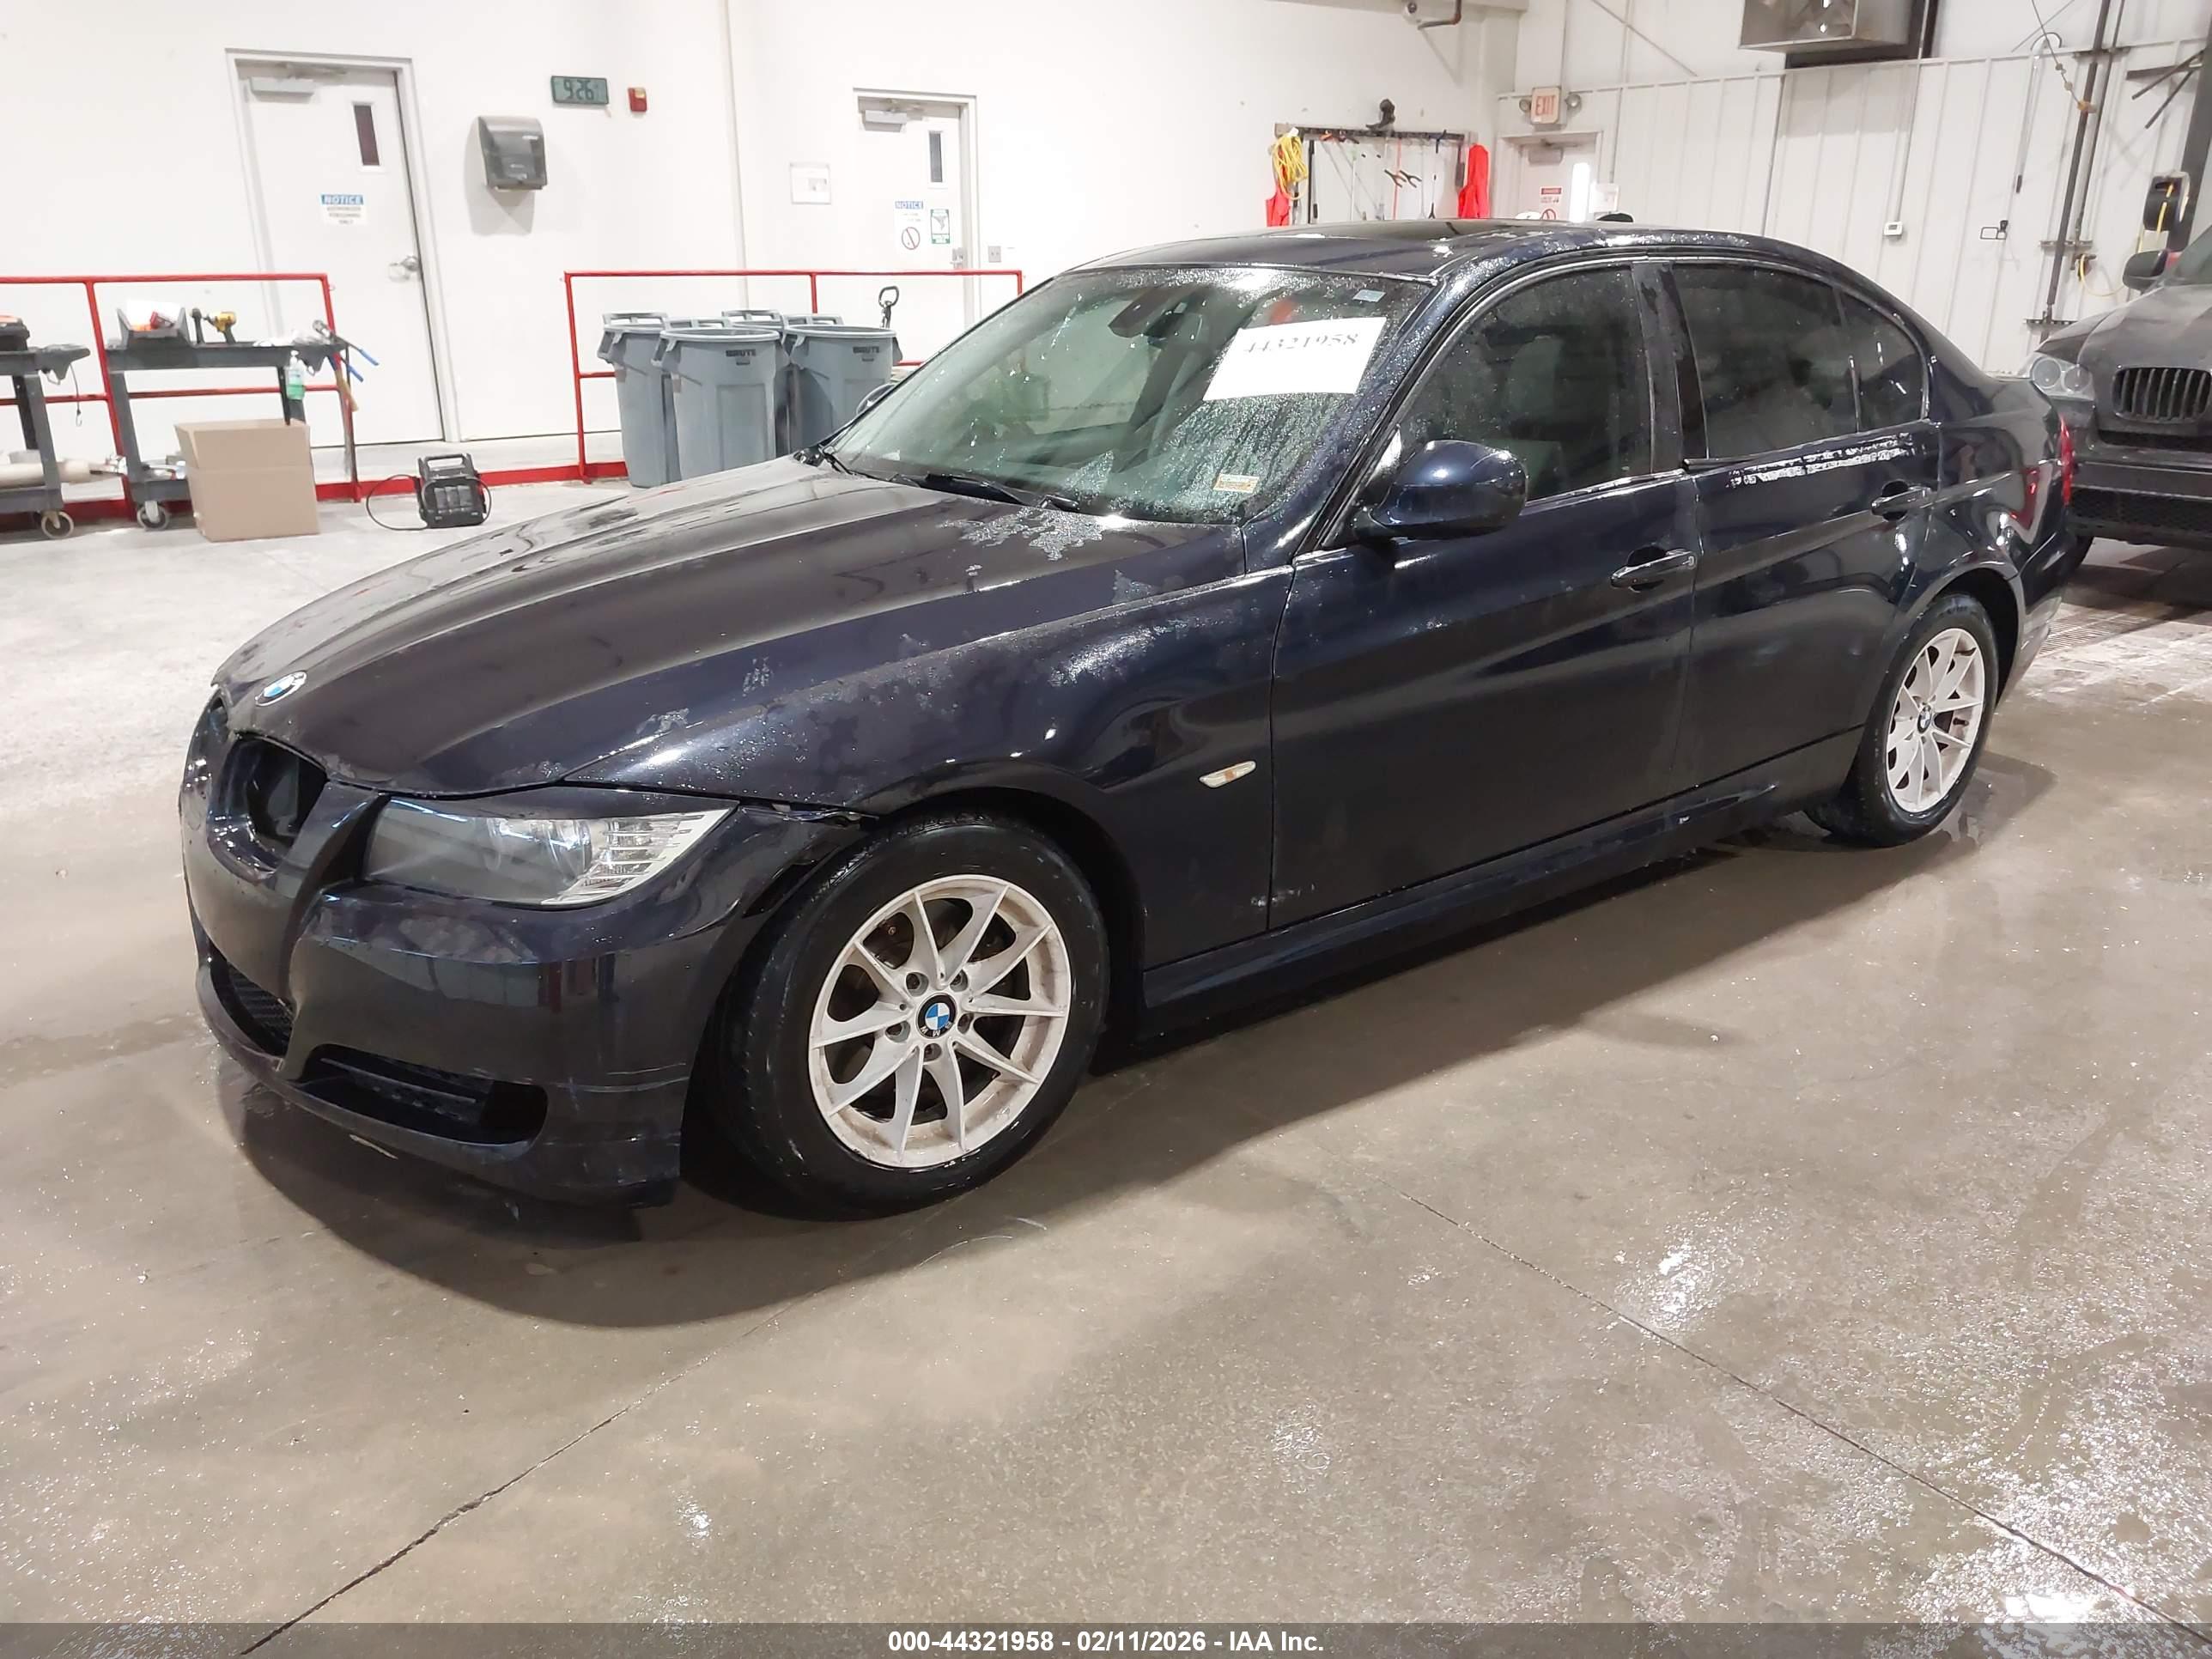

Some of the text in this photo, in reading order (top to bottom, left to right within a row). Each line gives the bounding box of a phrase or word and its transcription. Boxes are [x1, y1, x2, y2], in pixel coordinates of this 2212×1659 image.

[1535, 94, 1555, 116] EXIT
[324, 194, 361, 204] NOTICE
[896, 201, 921, 210] NOTICE
